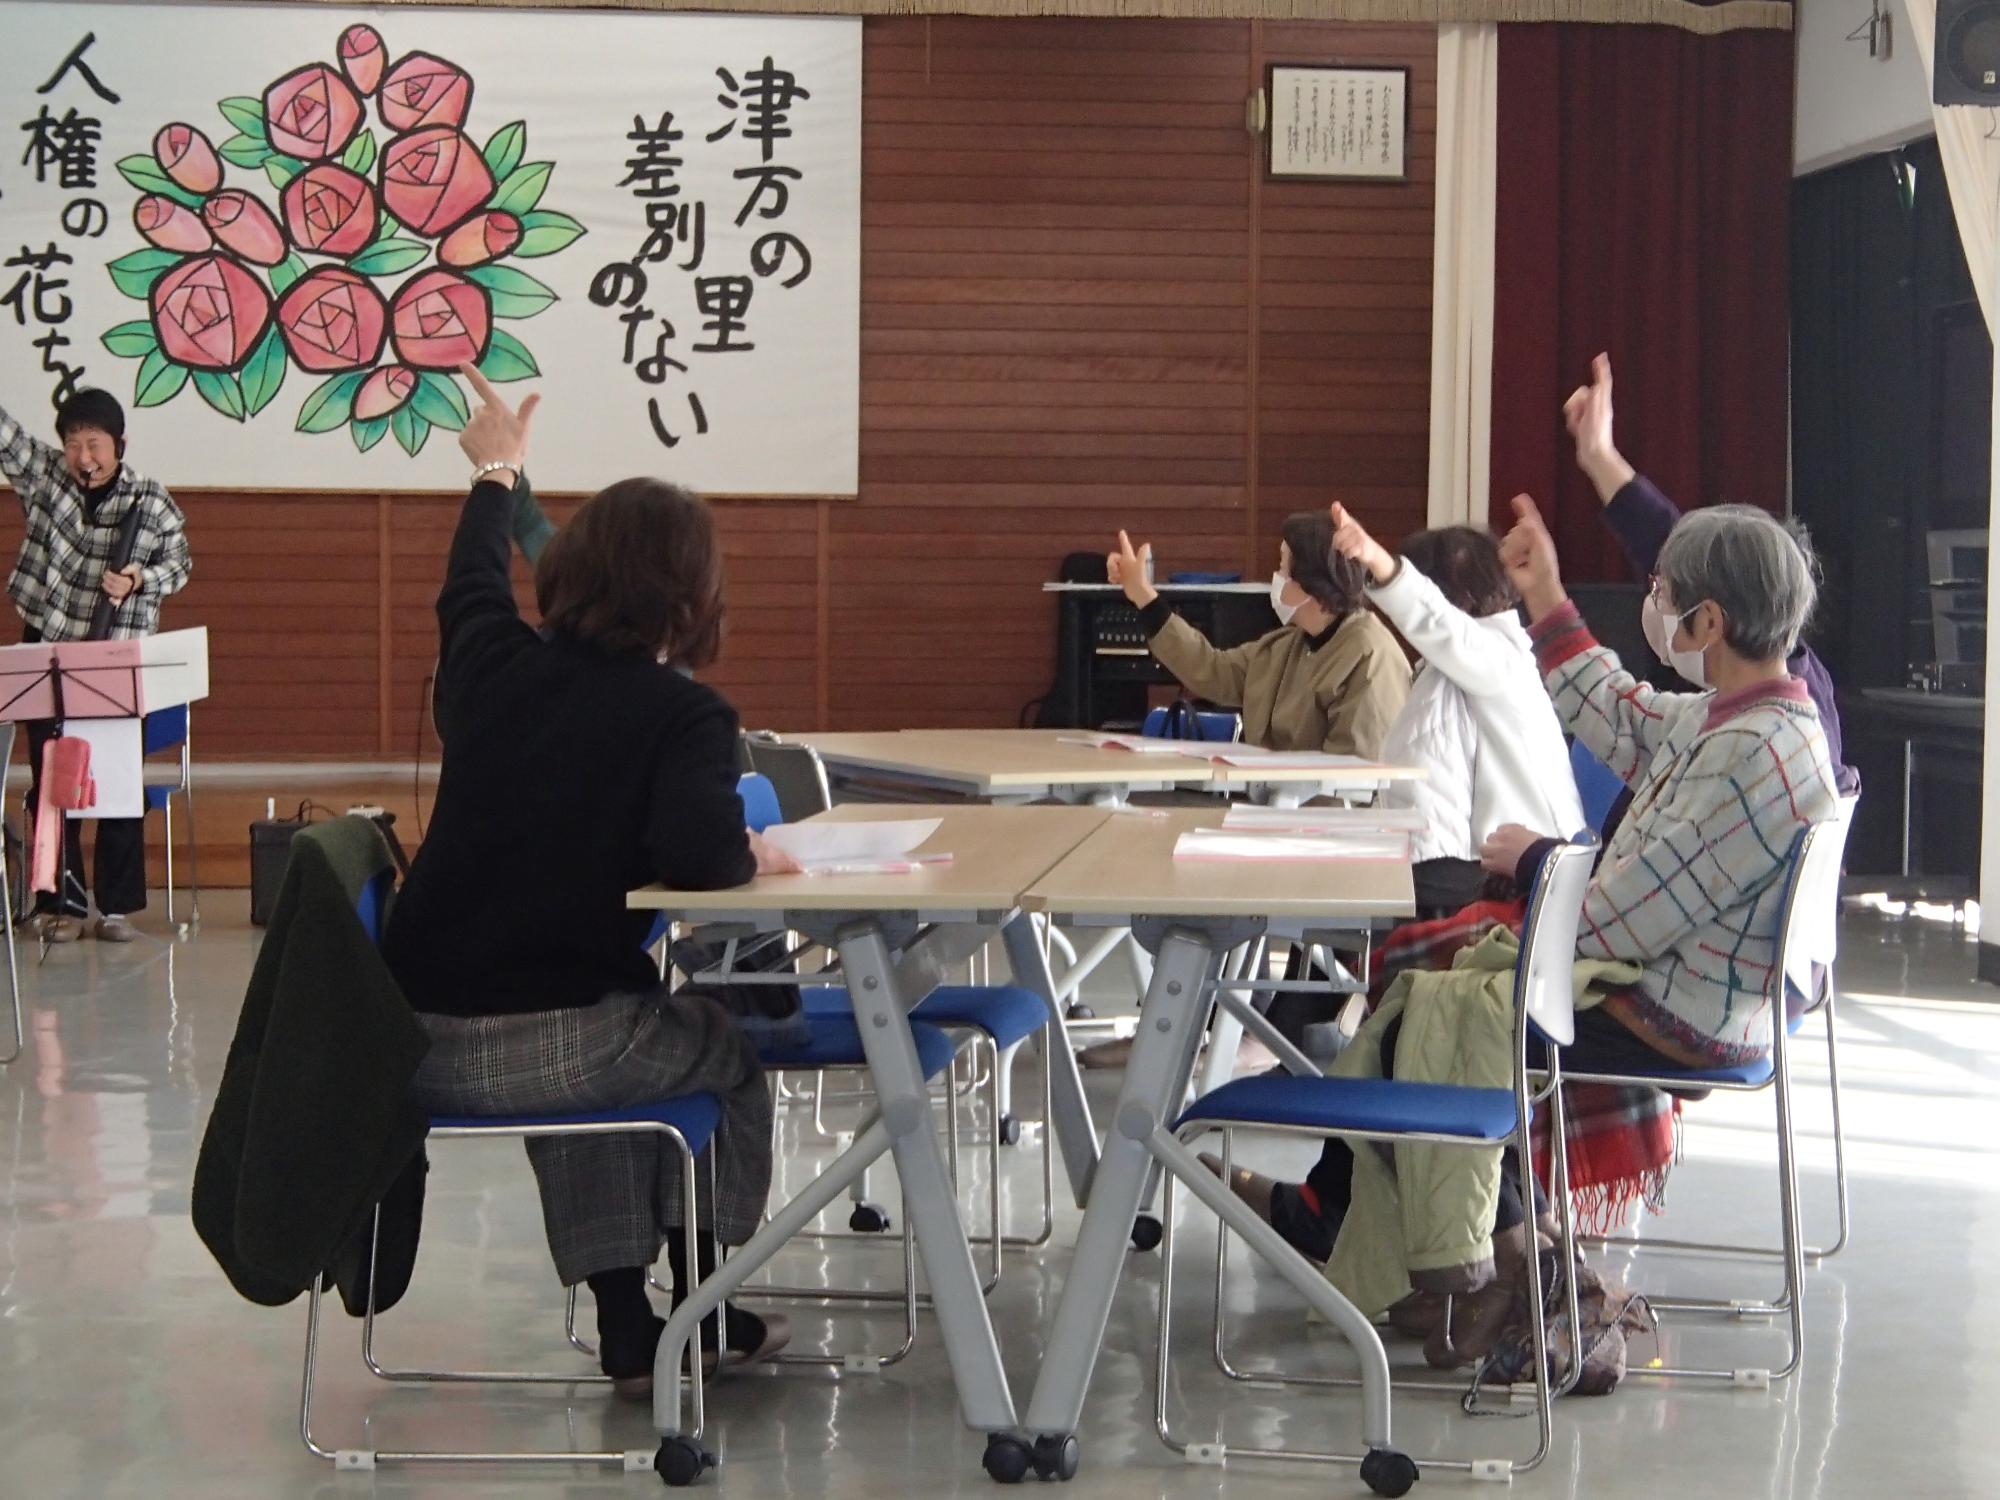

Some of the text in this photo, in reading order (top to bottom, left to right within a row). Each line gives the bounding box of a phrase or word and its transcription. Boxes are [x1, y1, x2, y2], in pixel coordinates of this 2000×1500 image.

[588, 111, 708, 448] 差別のない
[692, 56, 812, 353] 津万の里
